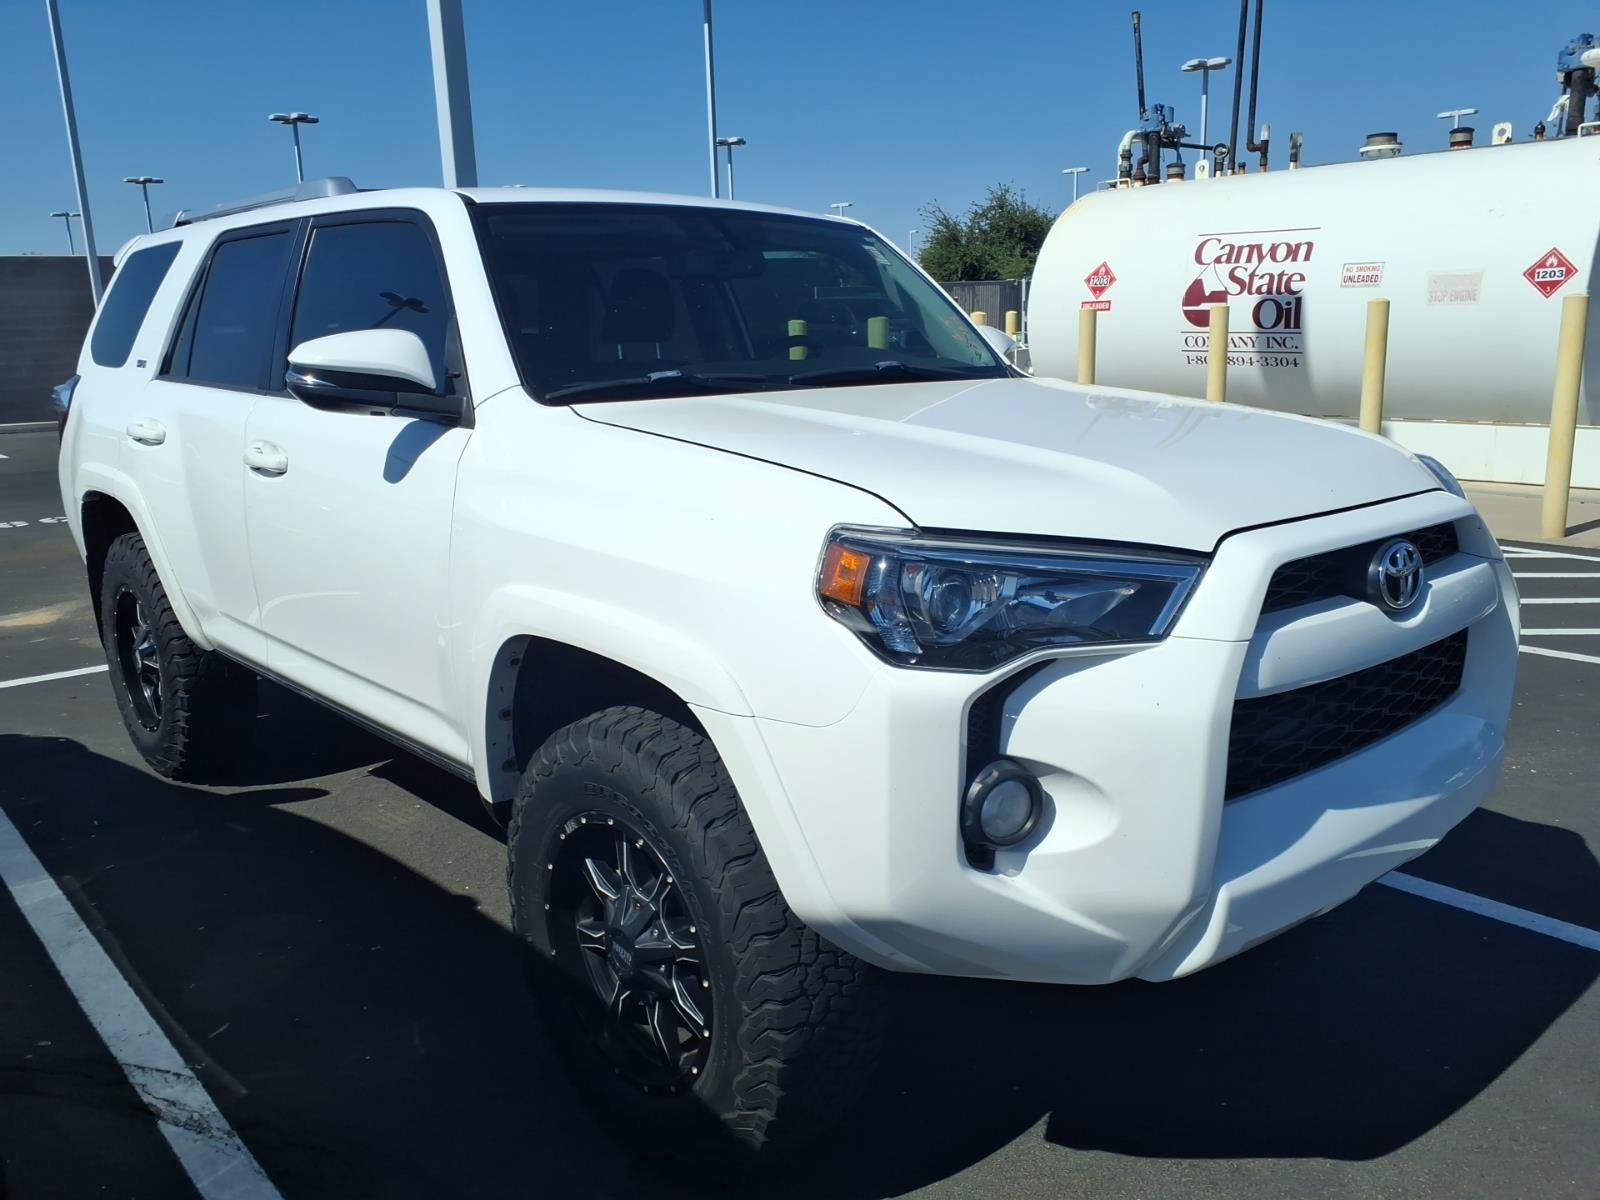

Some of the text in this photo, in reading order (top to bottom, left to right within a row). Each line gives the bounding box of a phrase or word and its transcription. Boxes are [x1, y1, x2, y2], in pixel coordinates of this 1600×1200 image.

[1194, 238, 1314, 272] Canyon
[1092, 276, 1108, 285] 1203
[1228, 265, 1306, 296] State
[1343, 274, 1379, 284] UNLEADED
[1536, 270, 1563, 279] 1203
[1252, 297, 1303, 329] Oil
[1184, 335, 1299, 350] COANY INC.
